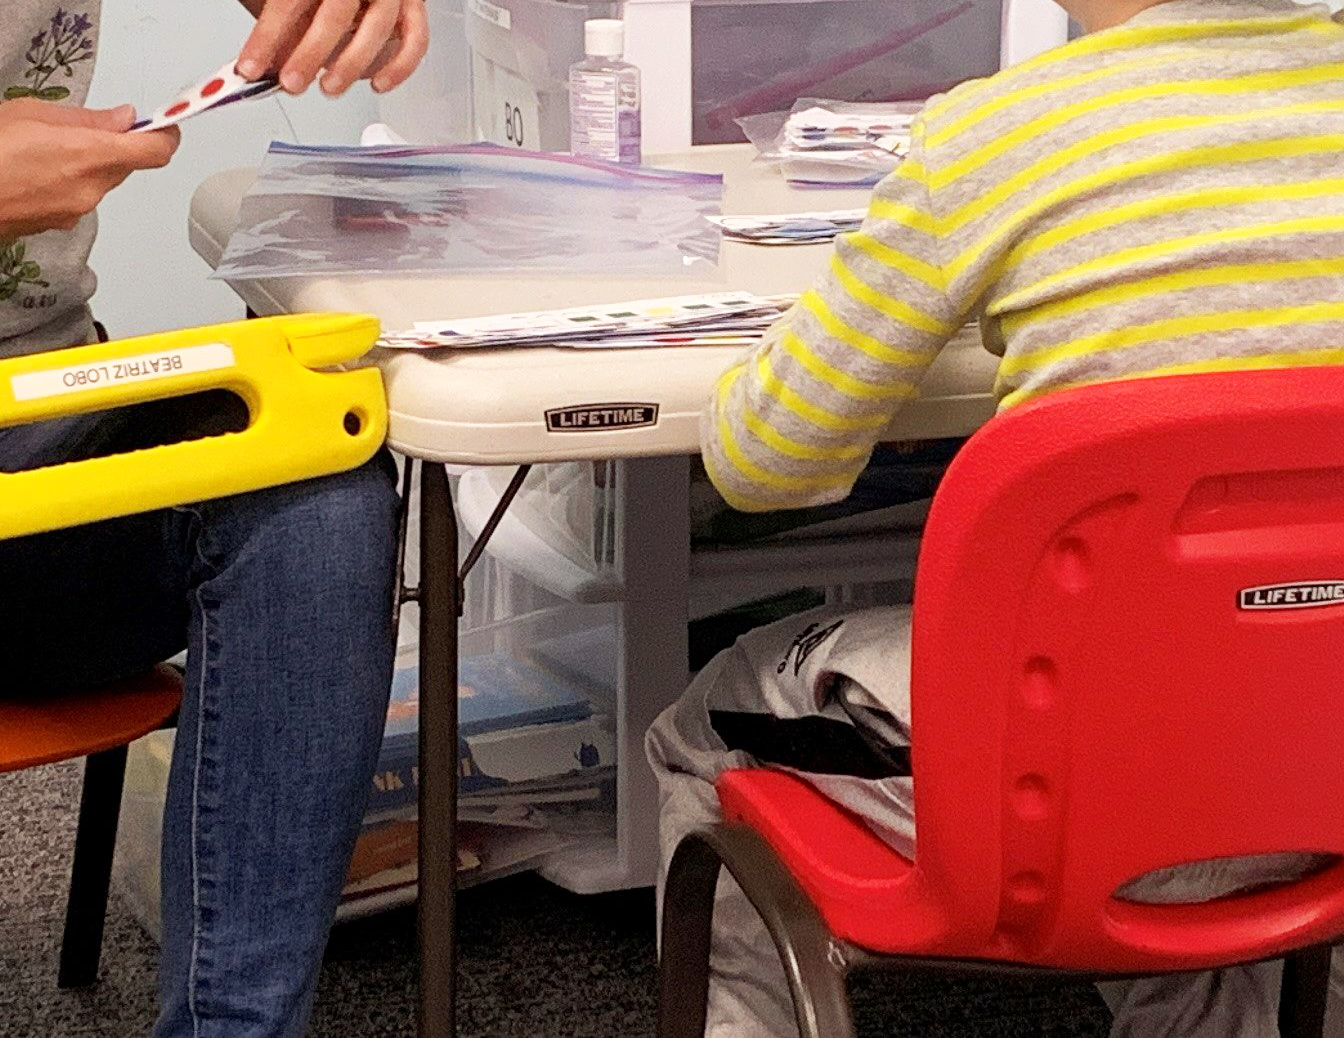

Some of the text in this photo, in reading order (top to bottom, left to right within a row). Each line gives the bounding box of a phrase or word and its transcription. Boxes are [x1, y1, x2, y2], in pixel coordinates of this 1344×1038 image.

[62, 354, 183, 387] BEATRIZ LOBO
[560, 408, 645, 427] LIFETIME
